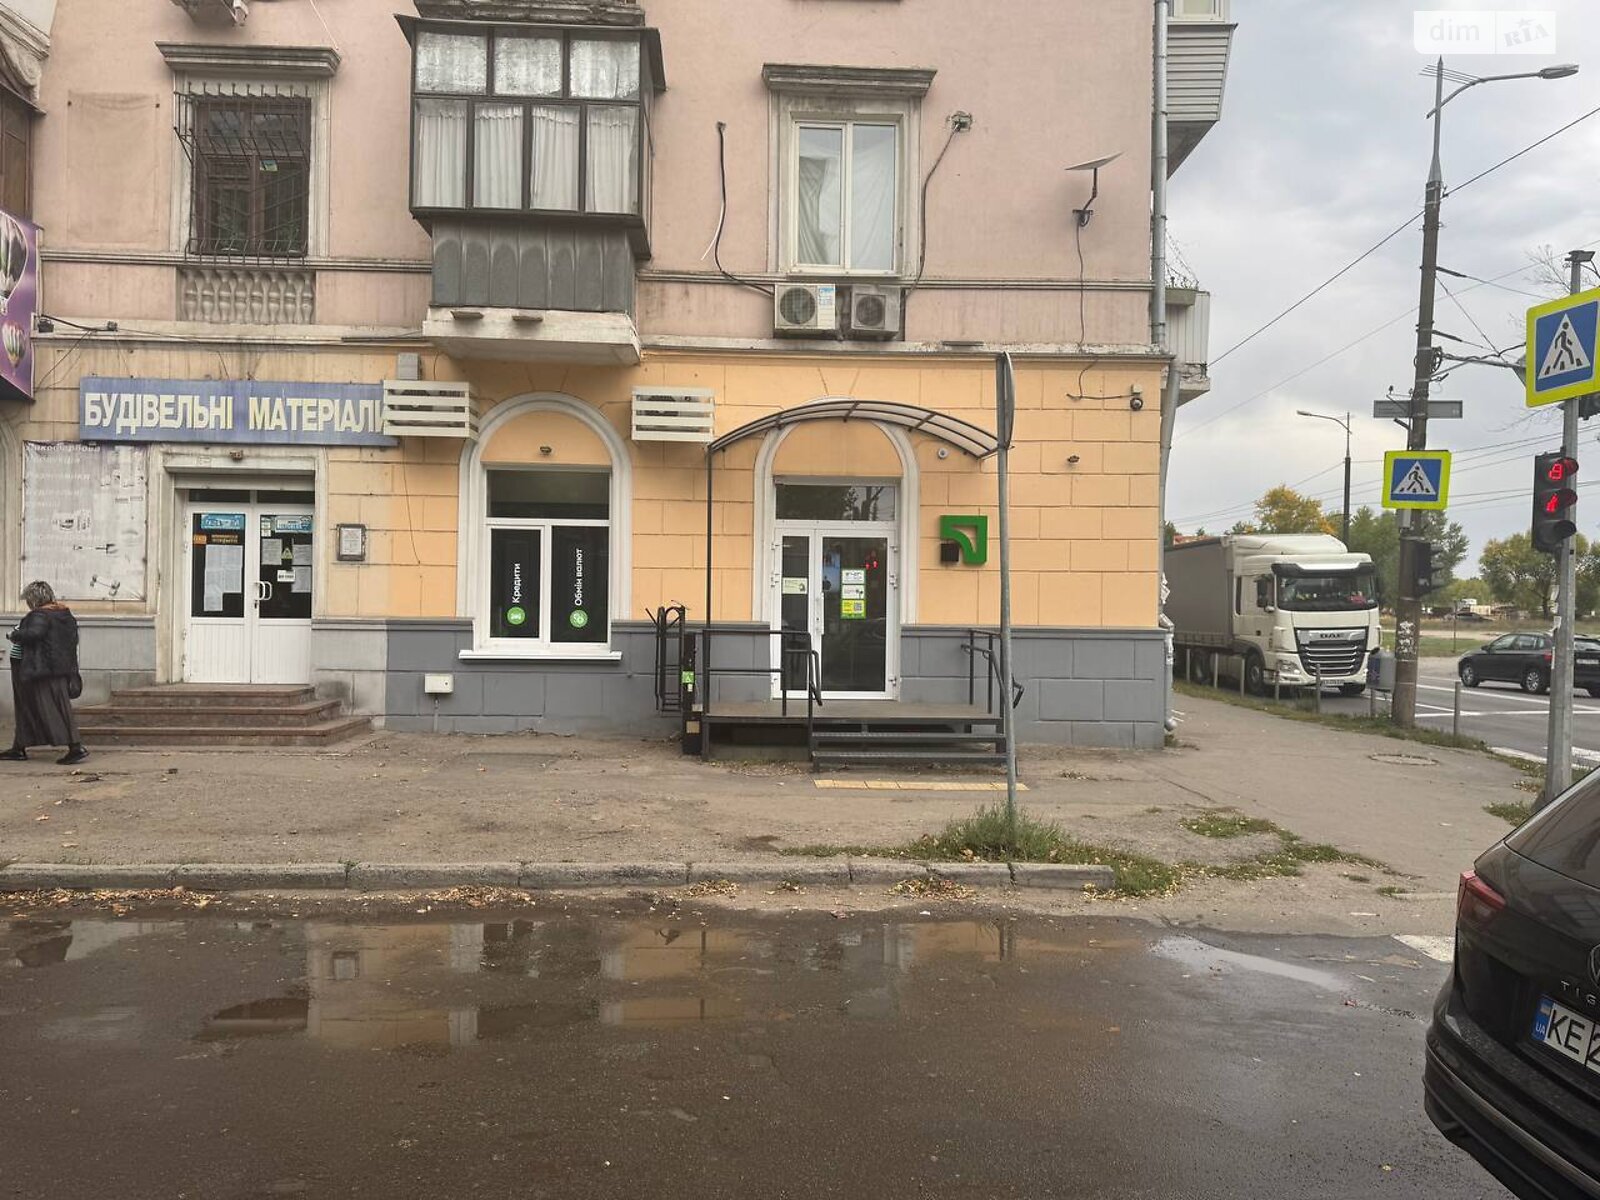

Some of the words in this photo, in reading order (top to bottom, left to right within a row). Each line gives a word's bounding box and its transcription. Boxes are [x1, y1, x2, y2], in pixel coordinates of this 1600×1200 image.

[84, 393, 233, 434] БУДІВЕЛЬНІ
[575, 548, 583, 577] валют
[512, 563, 522, 603] Кредити
[574, 578, 583, 606] Обмін
[1535, 1021, 1546, 1035] UA
